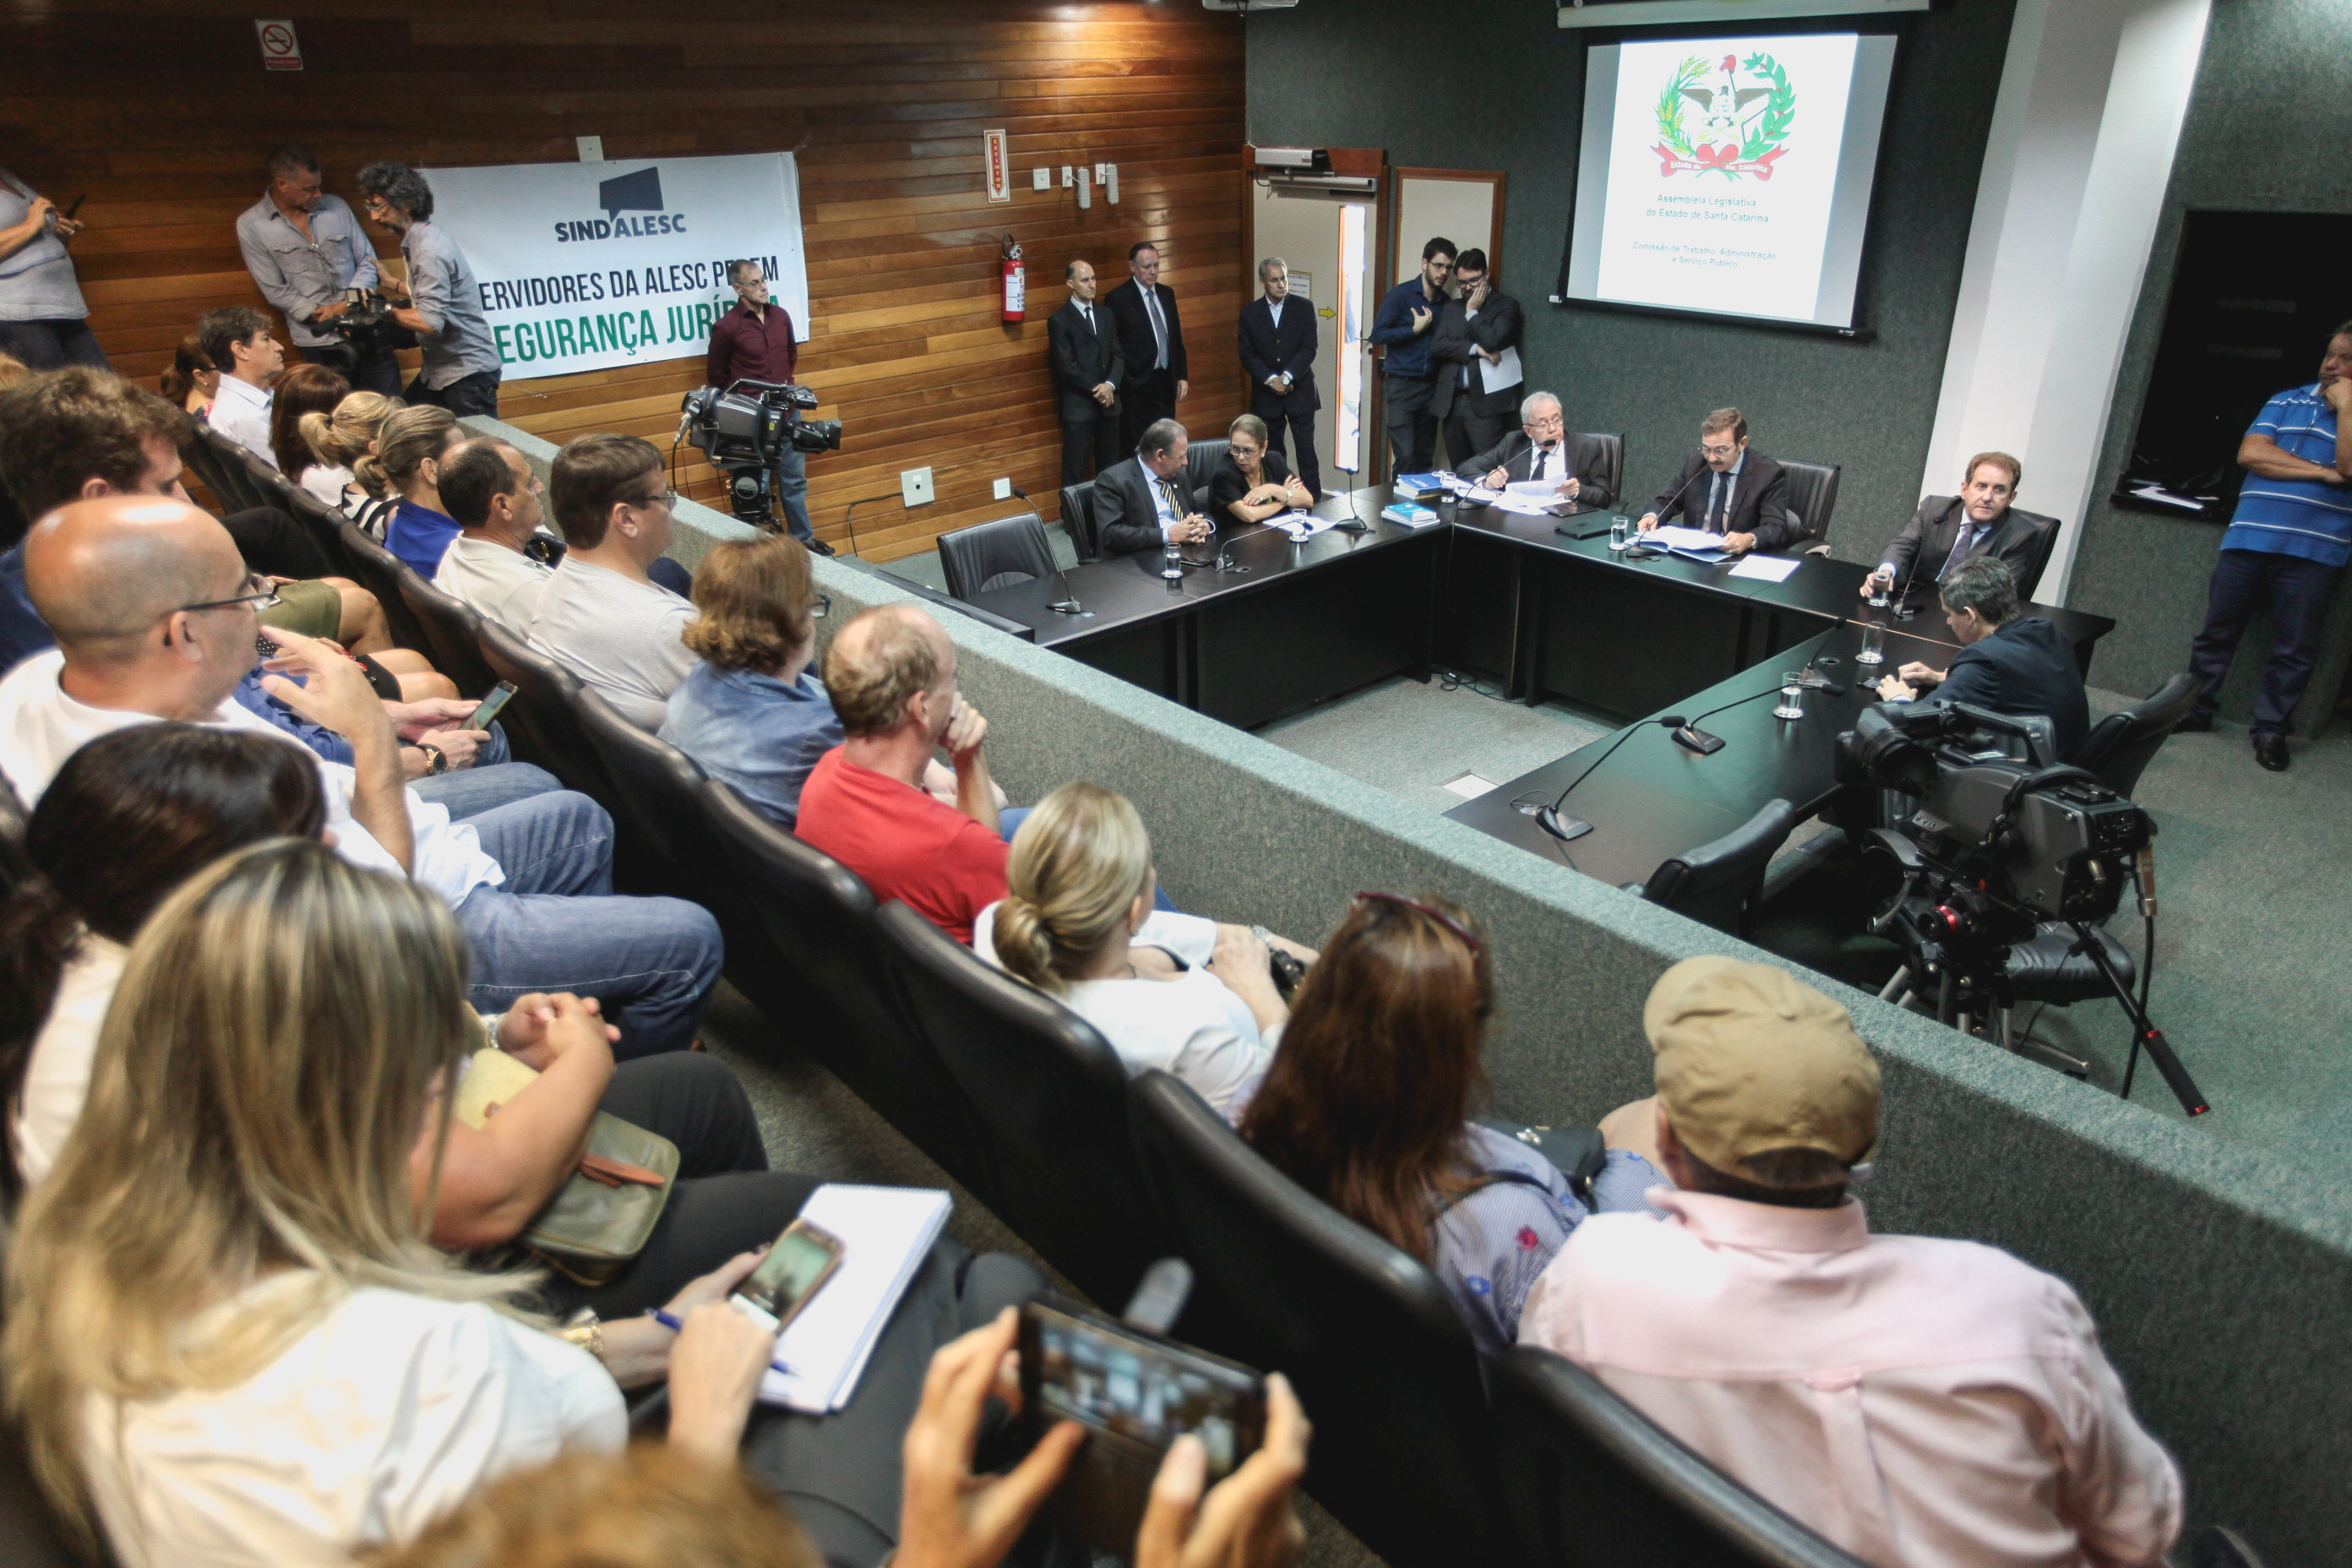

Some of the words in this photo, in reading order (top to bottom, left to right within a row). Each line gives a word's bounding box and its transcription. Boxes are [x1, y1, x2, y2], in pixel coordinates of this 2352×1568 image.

[993, 139, 1001, 188] EXTINTOR
[1657, 193, 1706, 204] Assembleia
[1708, 196, 1756, 208] Legislativa
[1646, 208, 1656, 216] do
[1658, 208, 1688, 218] Estado
[1690, 210, 1701, 219] de
[1703, 210, 1729, 220] Santa
[1731, 212, 1769, 223] Catarina
[1632, 242, 1669, 252] Comissão
[1670, 244, 1680, 253] de
[1719, 248, 1777, 260] Administração
[1679, 255, 1707, 266] Serviço
[478, 272, 605, 312] ERVIDORES
[609, 270, 640, 298] DA
[645, 263, 708, 295] ALESC
[493, 309, 659, 364] EGURANÇA
